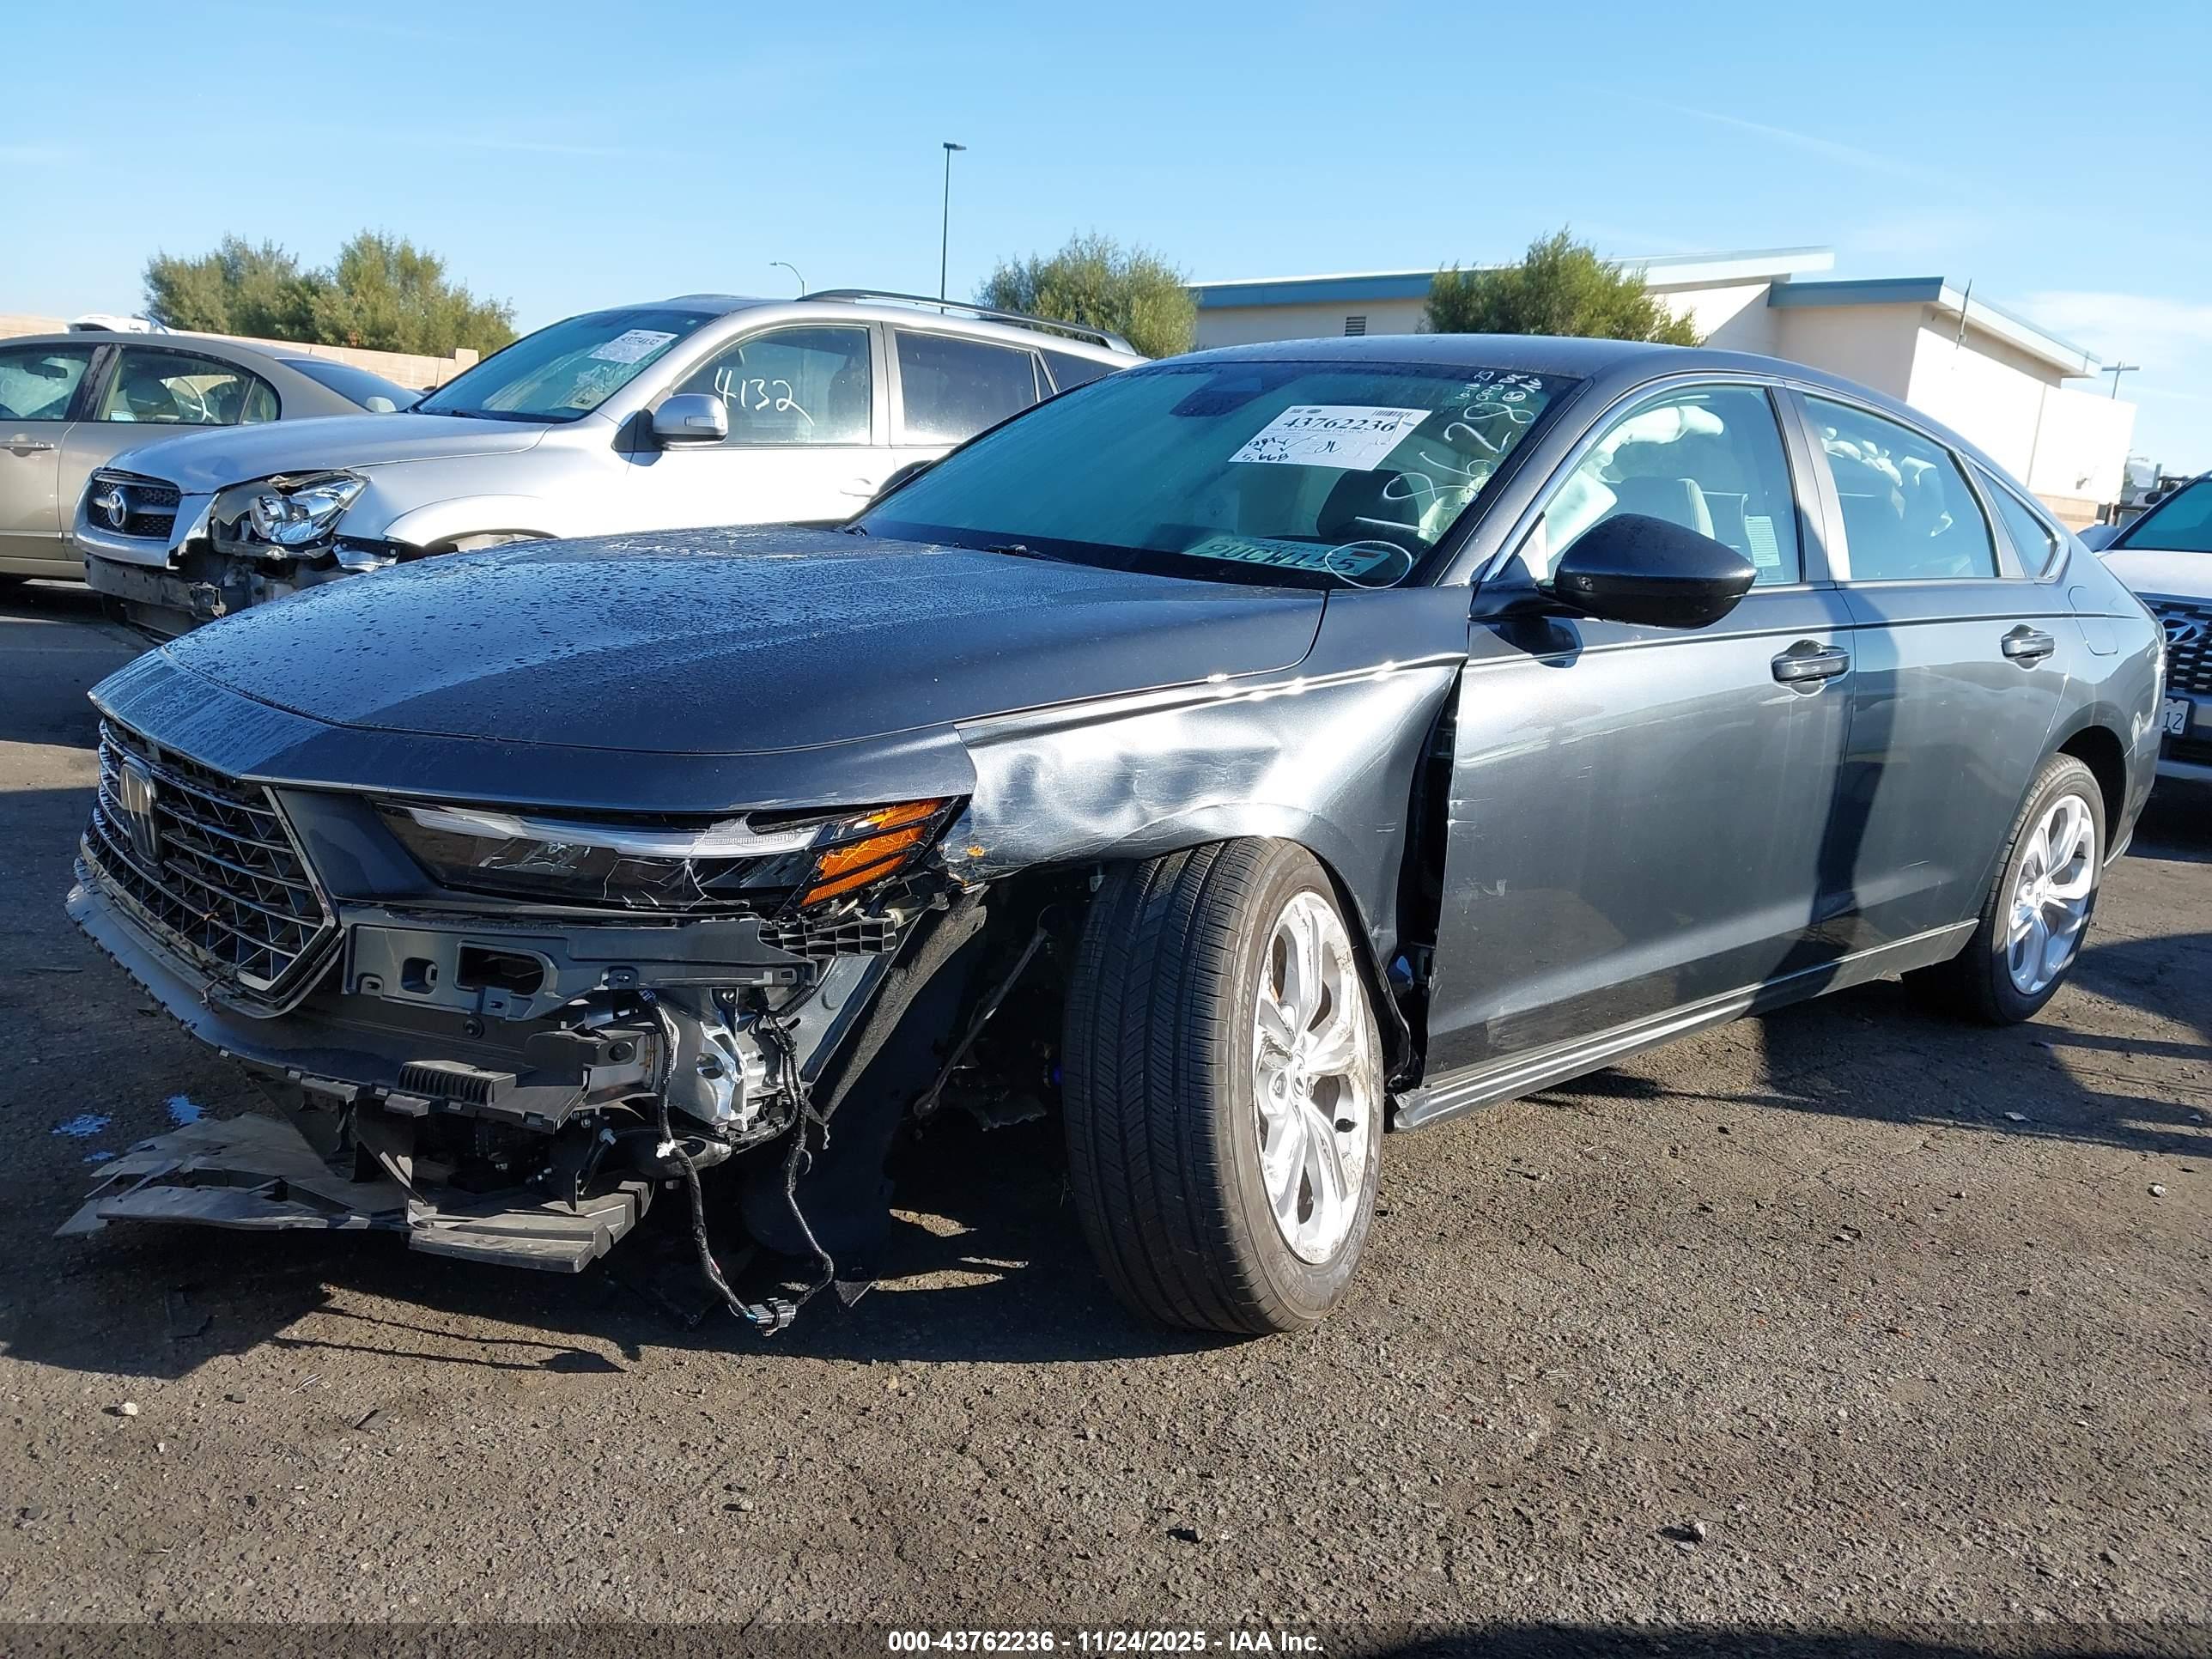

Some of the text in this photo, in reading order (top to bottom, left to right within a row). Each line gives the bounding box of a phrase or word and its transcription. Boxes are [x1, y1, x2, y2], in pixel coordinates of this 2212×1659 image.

[714, 367, 815, 426] 4132
[1284, 417, 1395, 432] 43762236
[1200, 544, 1361, 571] 9UCW155
